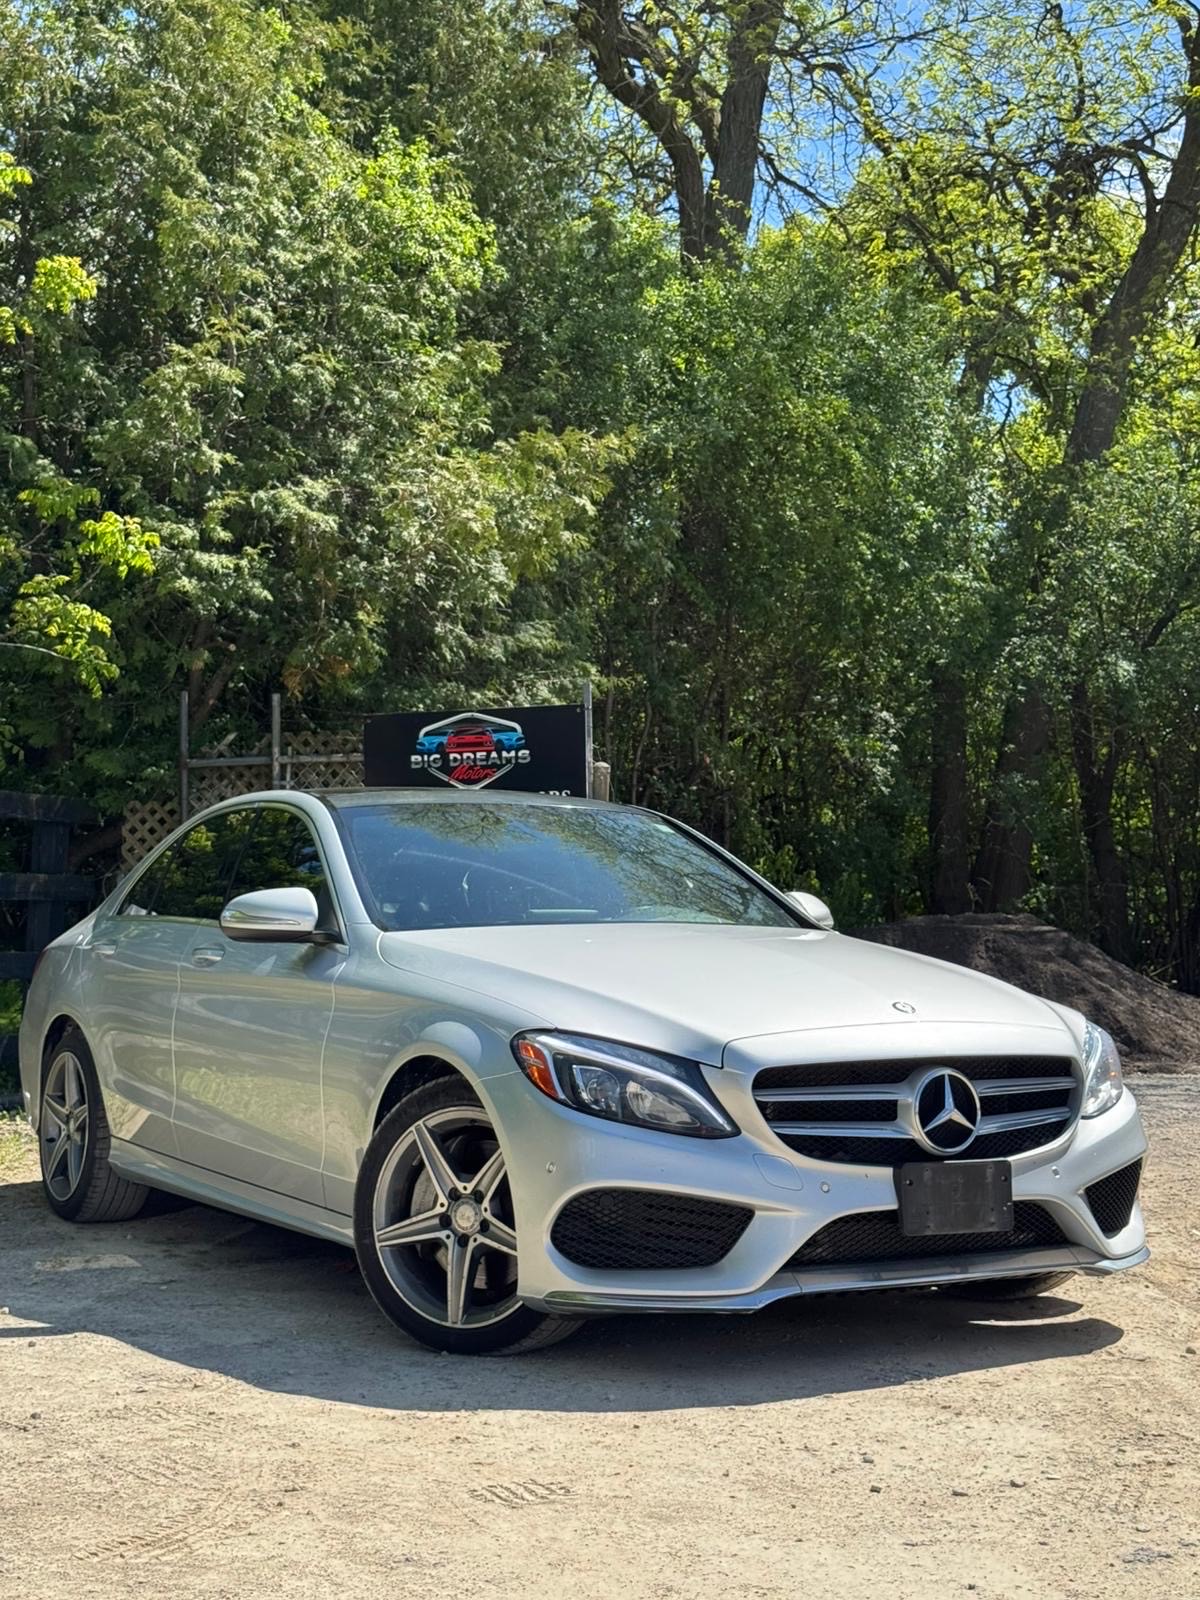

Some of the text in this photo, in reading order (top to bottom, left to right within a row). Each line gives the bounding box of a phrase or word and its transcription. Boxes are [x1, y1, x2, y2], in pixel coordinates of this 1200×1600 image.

[410, 749, 531, 768] BIG DREAMS
[448, 763, 497, 781] Motors
